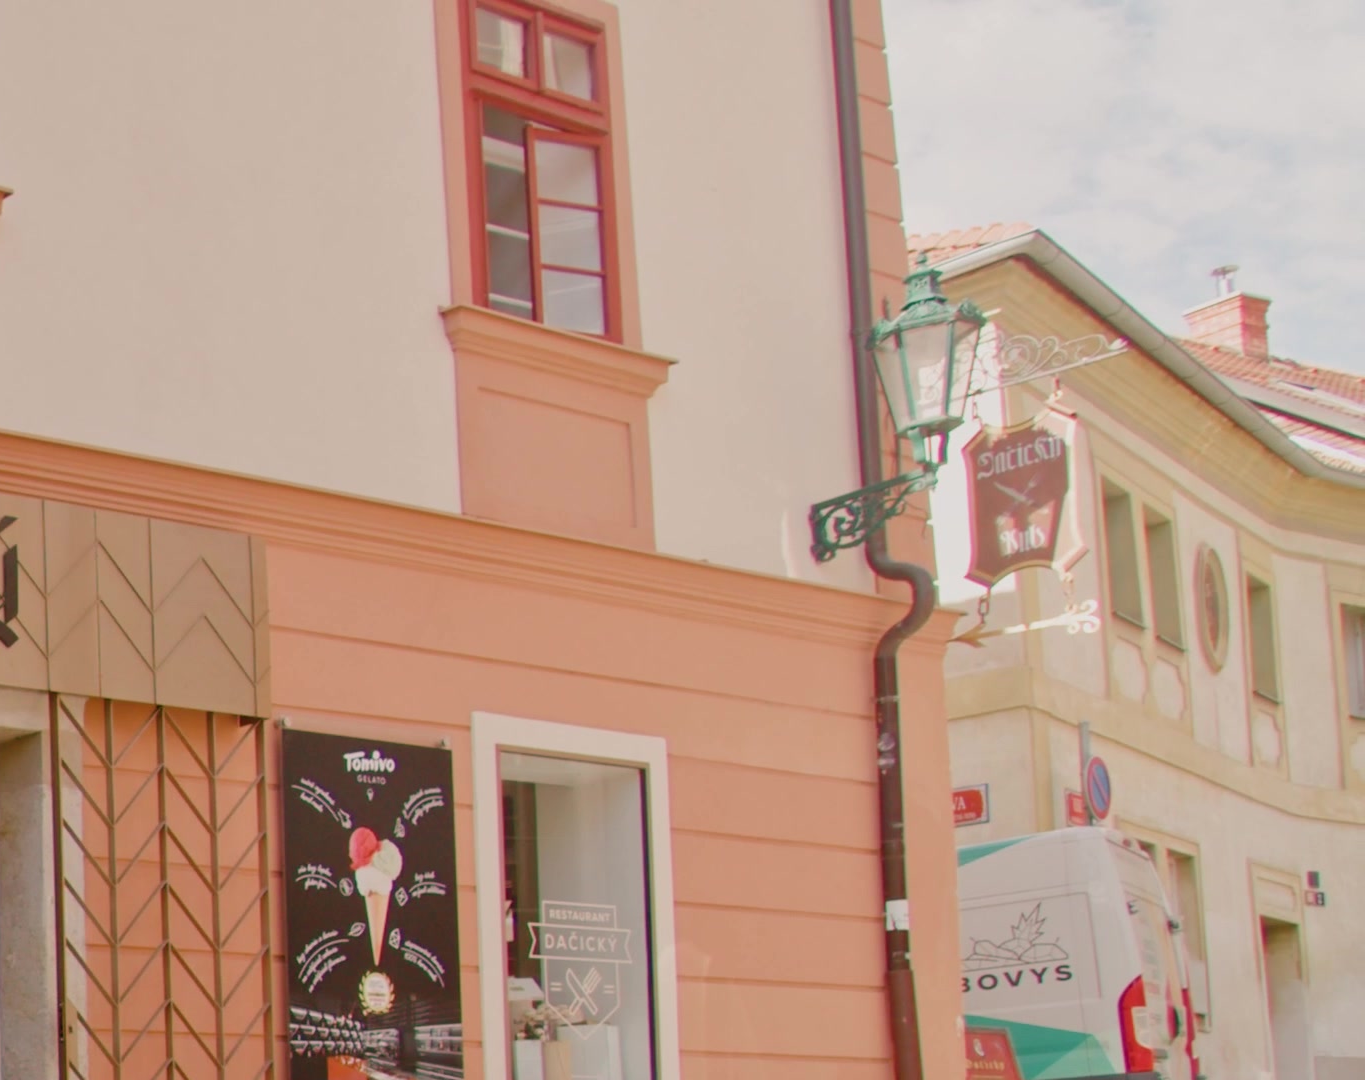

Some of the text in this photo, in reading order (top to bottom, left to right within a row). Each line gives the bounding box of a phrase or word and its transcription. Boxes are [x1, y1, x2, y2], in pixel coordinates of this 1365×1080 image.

[343, 750, 395, 773] Tomivo
[357, 774, 386, 785] GELATO
[549, 909, 610, 922] RESTAURANT
[545, 931, 617, 952] DAČICKÝ
